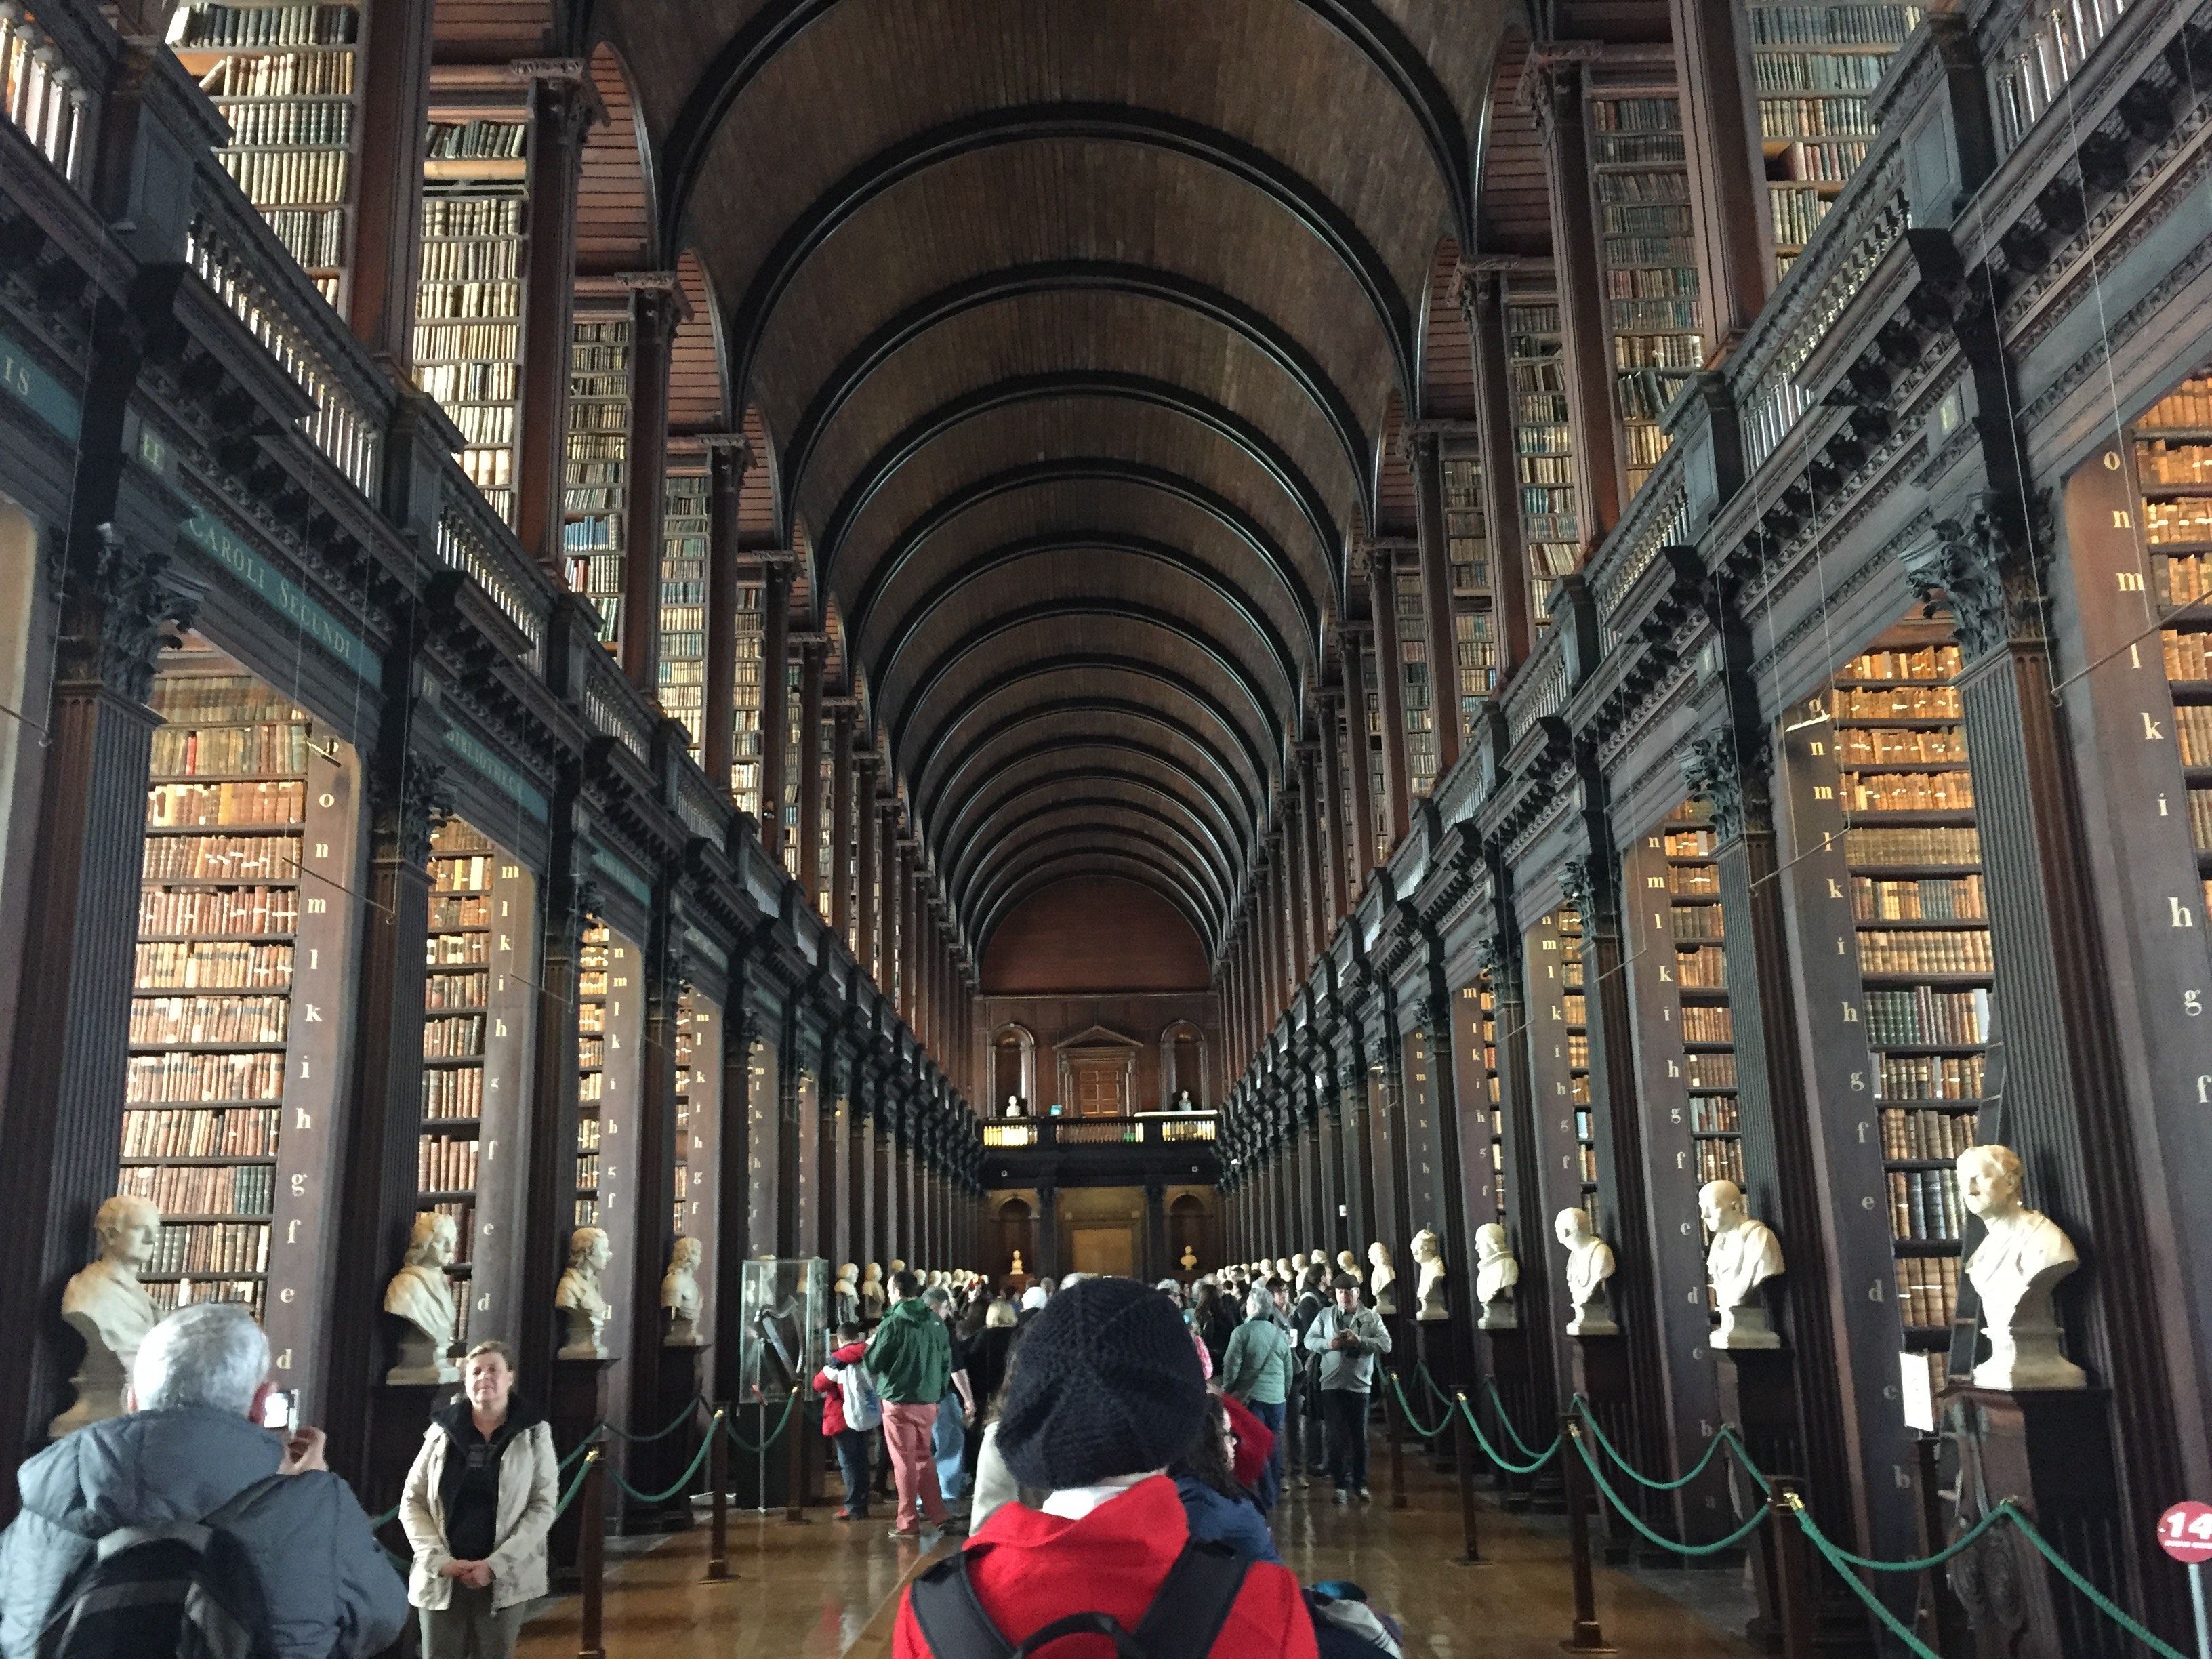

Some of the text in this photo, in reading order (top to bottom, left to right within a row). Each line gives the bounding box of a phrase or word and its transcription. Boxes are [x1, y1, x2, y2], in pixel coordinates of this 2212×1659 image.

[2104, 451, 2120, 470] o
[2114, 511, 2131, 528] n
[189, 504, 265, 589] CAROLI
[2116, 572, 2145, 592] m
[2141, 713, 2164, 739] k
[1810, 742, 1825, 755] n
[319, 794, 334, 807] o
[1814, 787, 1833, 799] m
[2158, 793, 2168, 816] i
[1649, 838, 1660, 847] n
[316, 844, 328, 857] n
[502, 866, 518, 878] m
[1647, 877, 1664, 888] m
[1827, 879, 1843, 898] k
[308, 899, 326, 913] m
[2168, 897, 2192, 927] h
[1542, 916, 1551, 924] n
[500, 935, 511, 950] k
[1542, 941, 1556, 949] m
[1837, 937, 1845, 954] i
[614, 948, 624, 958] n
[1660, 966, 1673, 981] k
[613, 977, 627, 987] m
[1463, 988, 1477, 998] m
[2184, 990, 2202, 1016] g
[306, 1004, 322, 1021] k
[1552, 1006, 1562, 1019] k
[1664, 1007, 1669, 1021] i
[1842, 1002, 1858, 1021] h
[495, 1019, 506, 1036] h
[612, 1034, 620, 1048] k
[1473, 1049, 1480, 1060] k
[300, 1056, 310, 1078] i
[1668, 1060, 1679, 1077] h
[490, 1076, 499, 1089] g
[697, 1071, 705, 1082] k
[1851, 1072, 1864, 1091] g
[1557, 1082, 1565, 1094] h
[2197, 1075, 2212, 1103] f
[296, 1108, 310, 1129] h
[1477, 1110, 1485, 1122] h
[1671, 1108, 1681, 1124] g
[609, 1120, 617, 1133] h
[1857, 1122, 1869, 1143] f
[695, 1136, 702, 1148] h
[489, 1141, 497, 1160] f
[1677, 1152, 1685, 1168] f
[291, 1174, 308, 1196] g
[1862, 1197, 1874, 1210] e
[287, 1220, 301, 1244] f
[483, 1223, 493, 1235] e
[1681, 1223, 1690, 1235] e
[281, 1288, 294, 1303] e
[1688, 1287, 1698, 1304] d
[1868, 1279, 1883, 1302] d
[477, 1293, 490, 1311] d
[276, 1349, 291, 1369] d
[1883, 1385, 1898, 1399] c
[1893, 1465, 1910, 1488] b
[2167, 1511, 2212, 1540] 14
